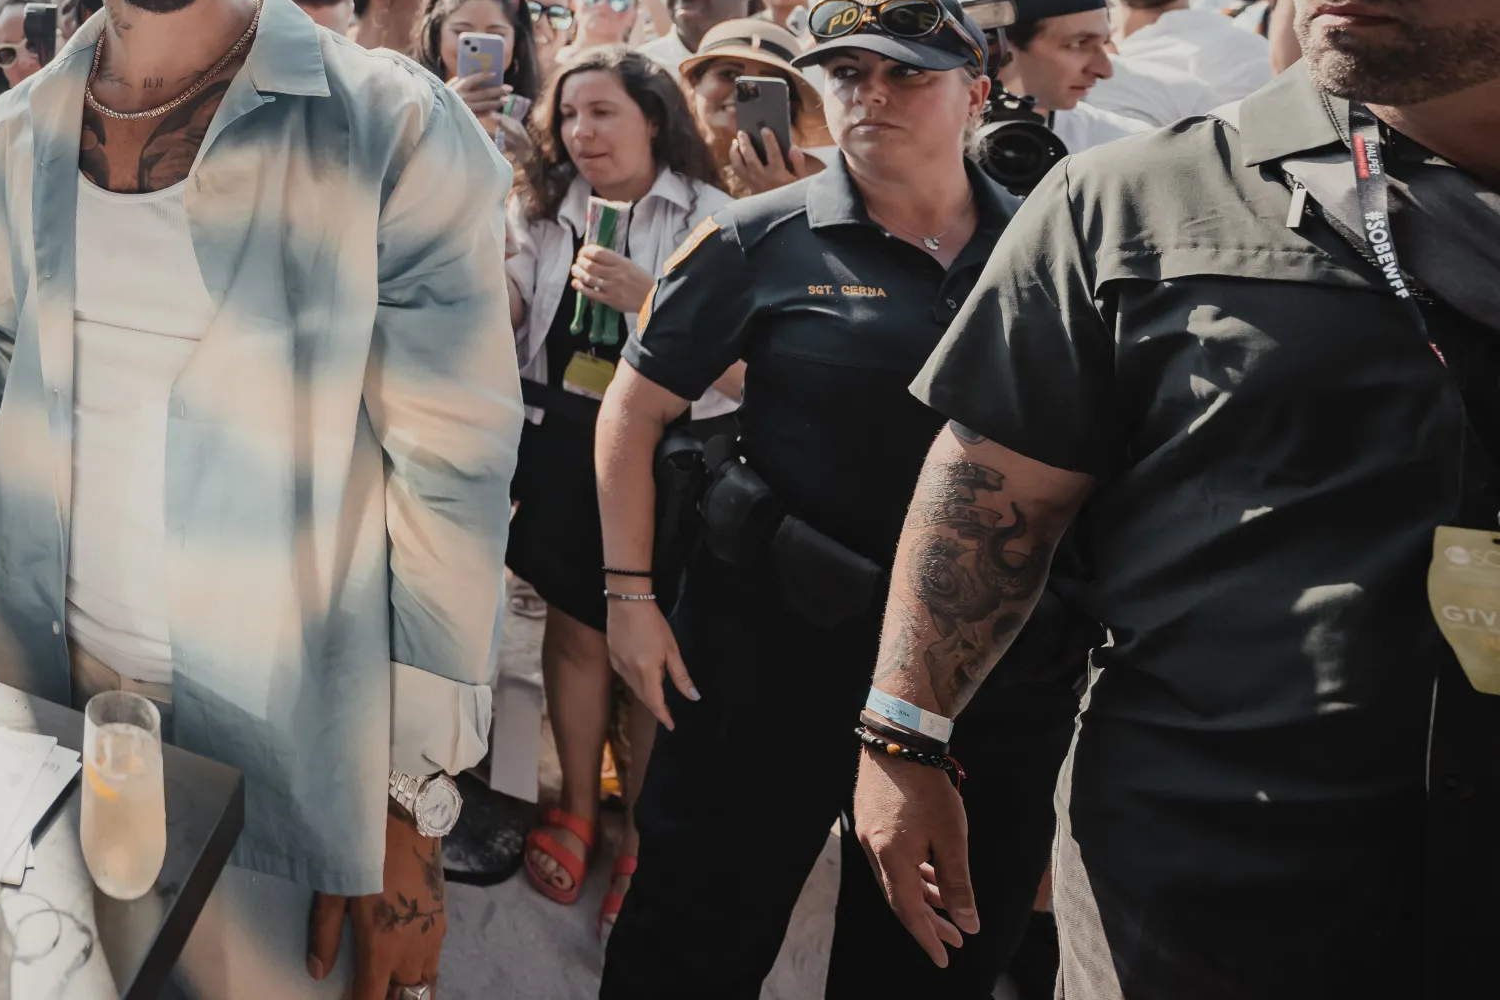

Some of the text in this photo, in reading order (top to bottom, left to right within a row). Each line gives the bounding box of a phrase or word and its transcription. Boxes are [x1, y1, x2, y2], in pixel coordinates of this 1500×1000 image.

[828, 7, 937, 35] POCE
[1364, 143, 1381, 175] HALPER
[1364, 210, 1410, 299] #SOBEWFF
[807, 285, 835, 295] SGT.
[1441, 604, 1497, 626] GTV
